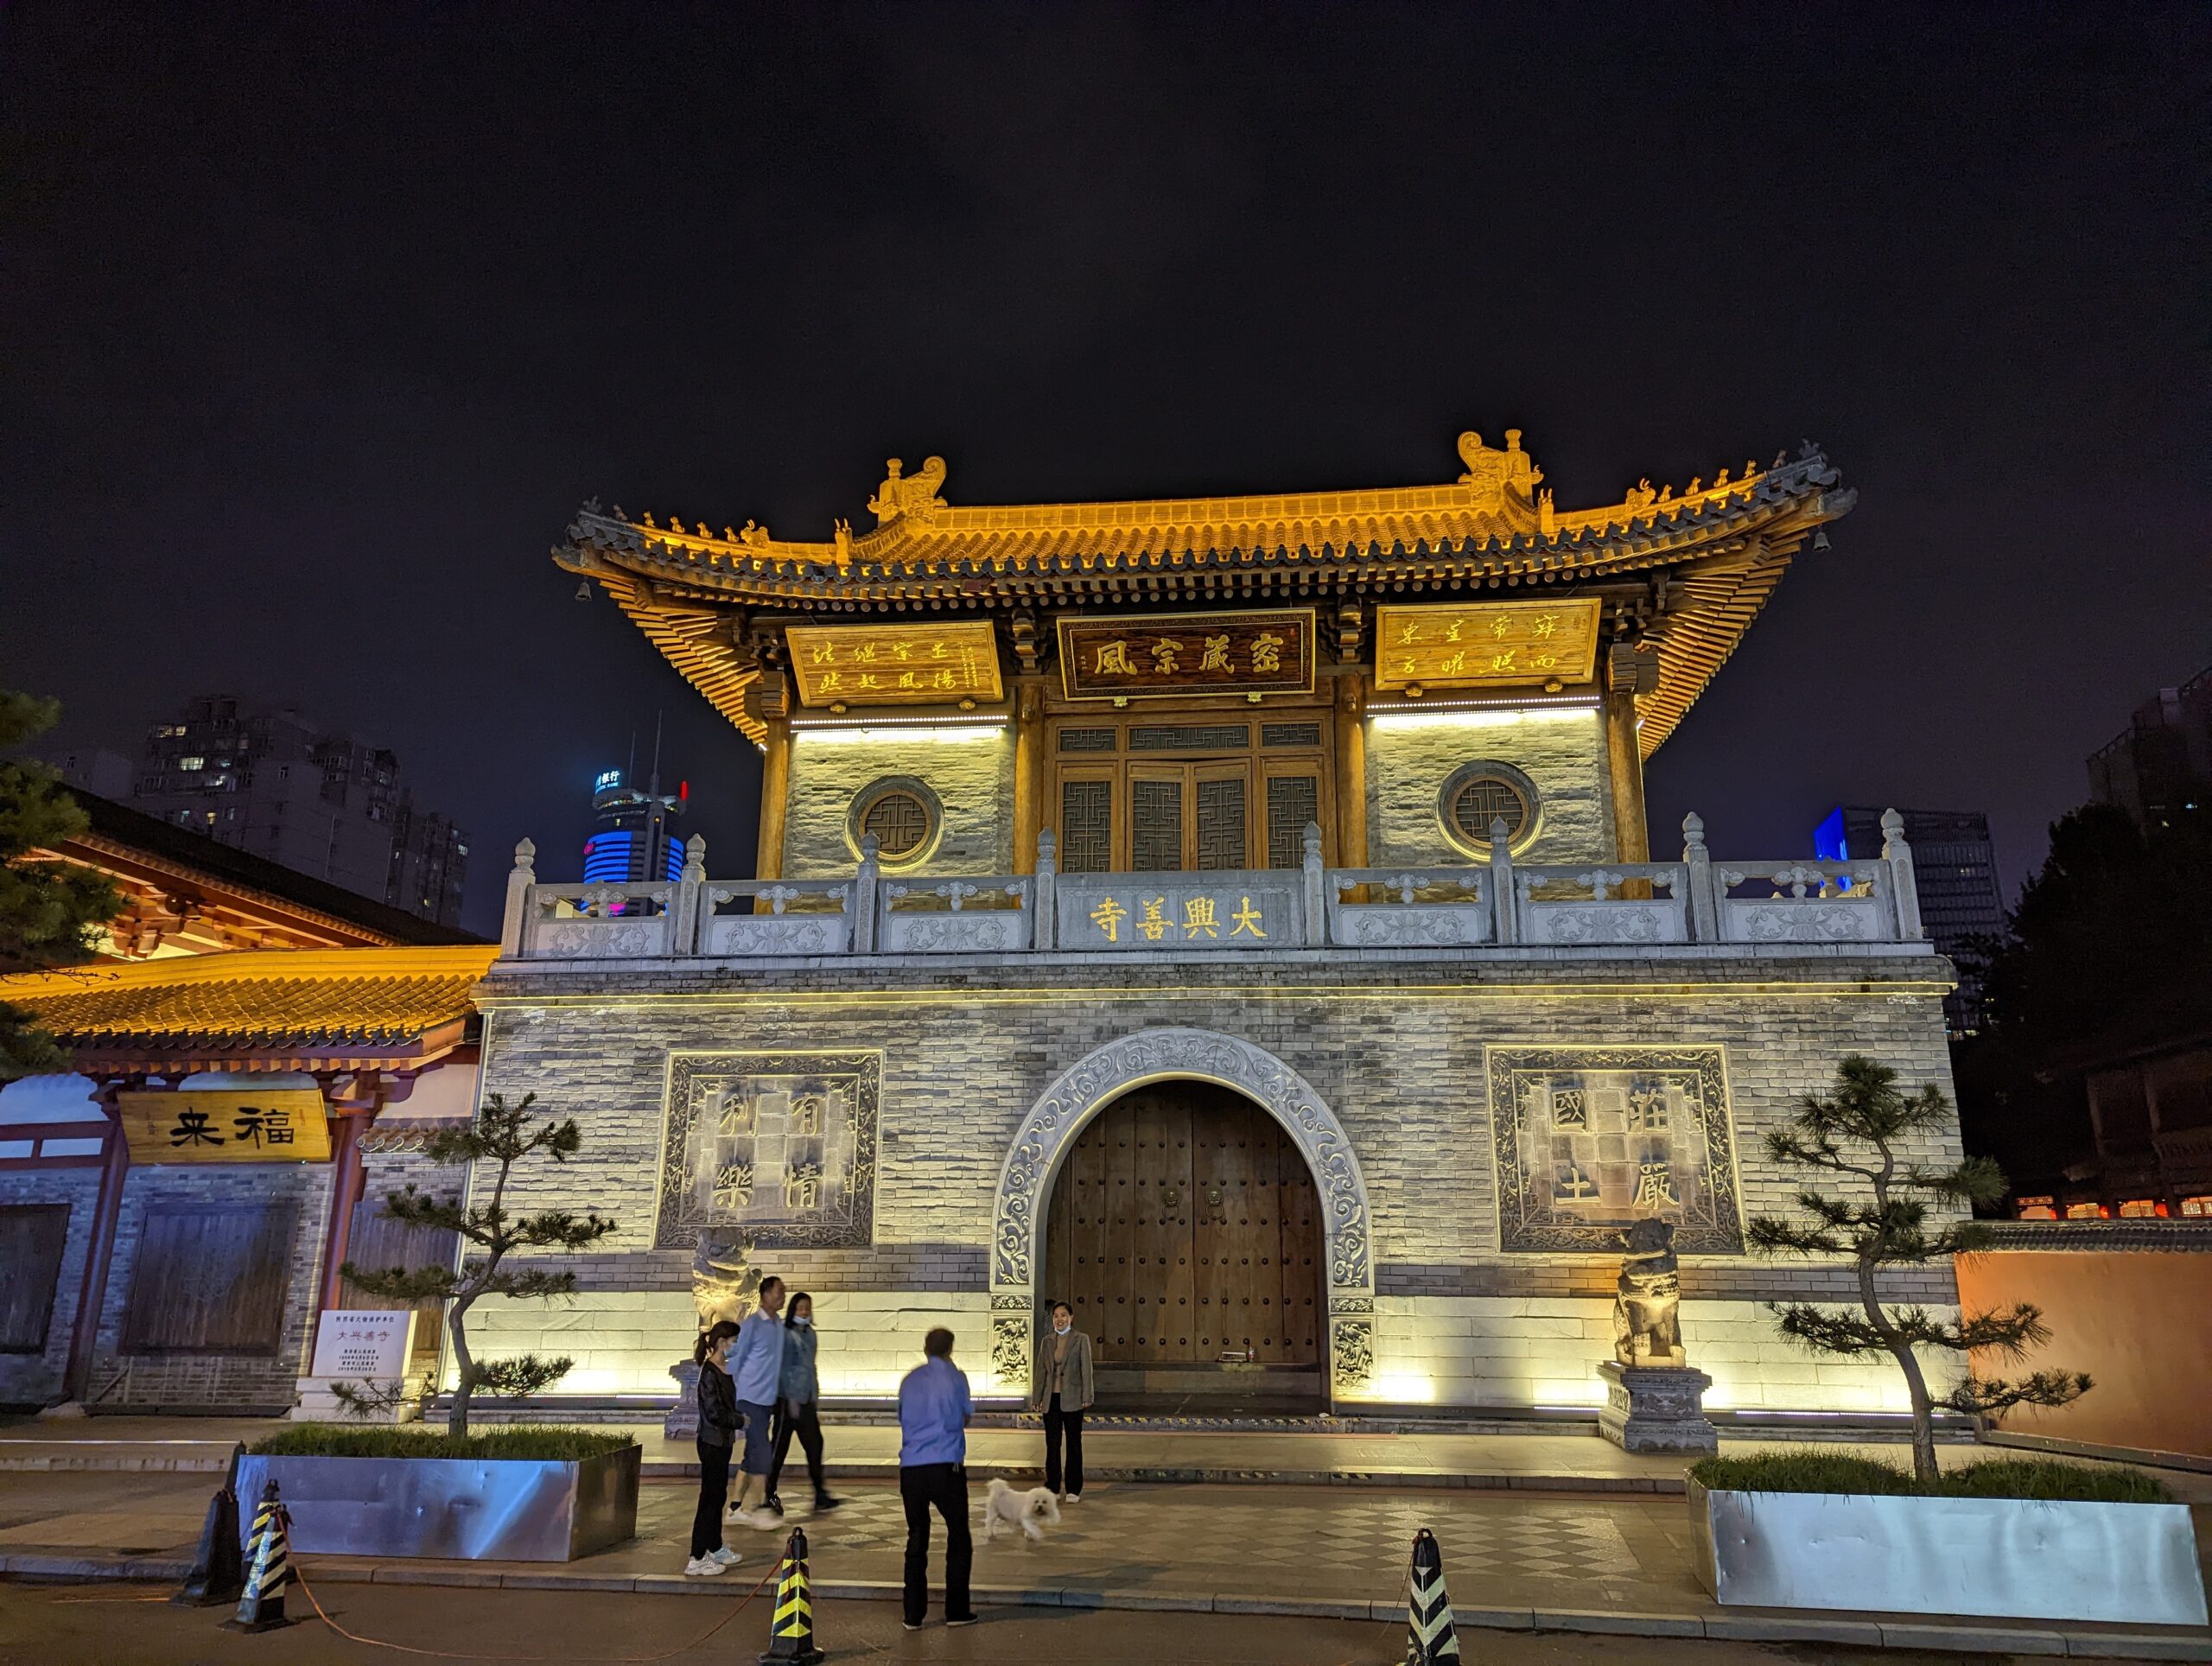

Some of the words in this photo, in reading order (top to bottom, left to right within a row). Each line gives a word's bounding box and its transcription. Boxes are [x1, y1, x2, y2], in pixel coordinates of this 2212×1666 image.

[1089, 895, 1268, 943] 大興善寺
[337, 1330, 391, 1342] 大兴善寺
